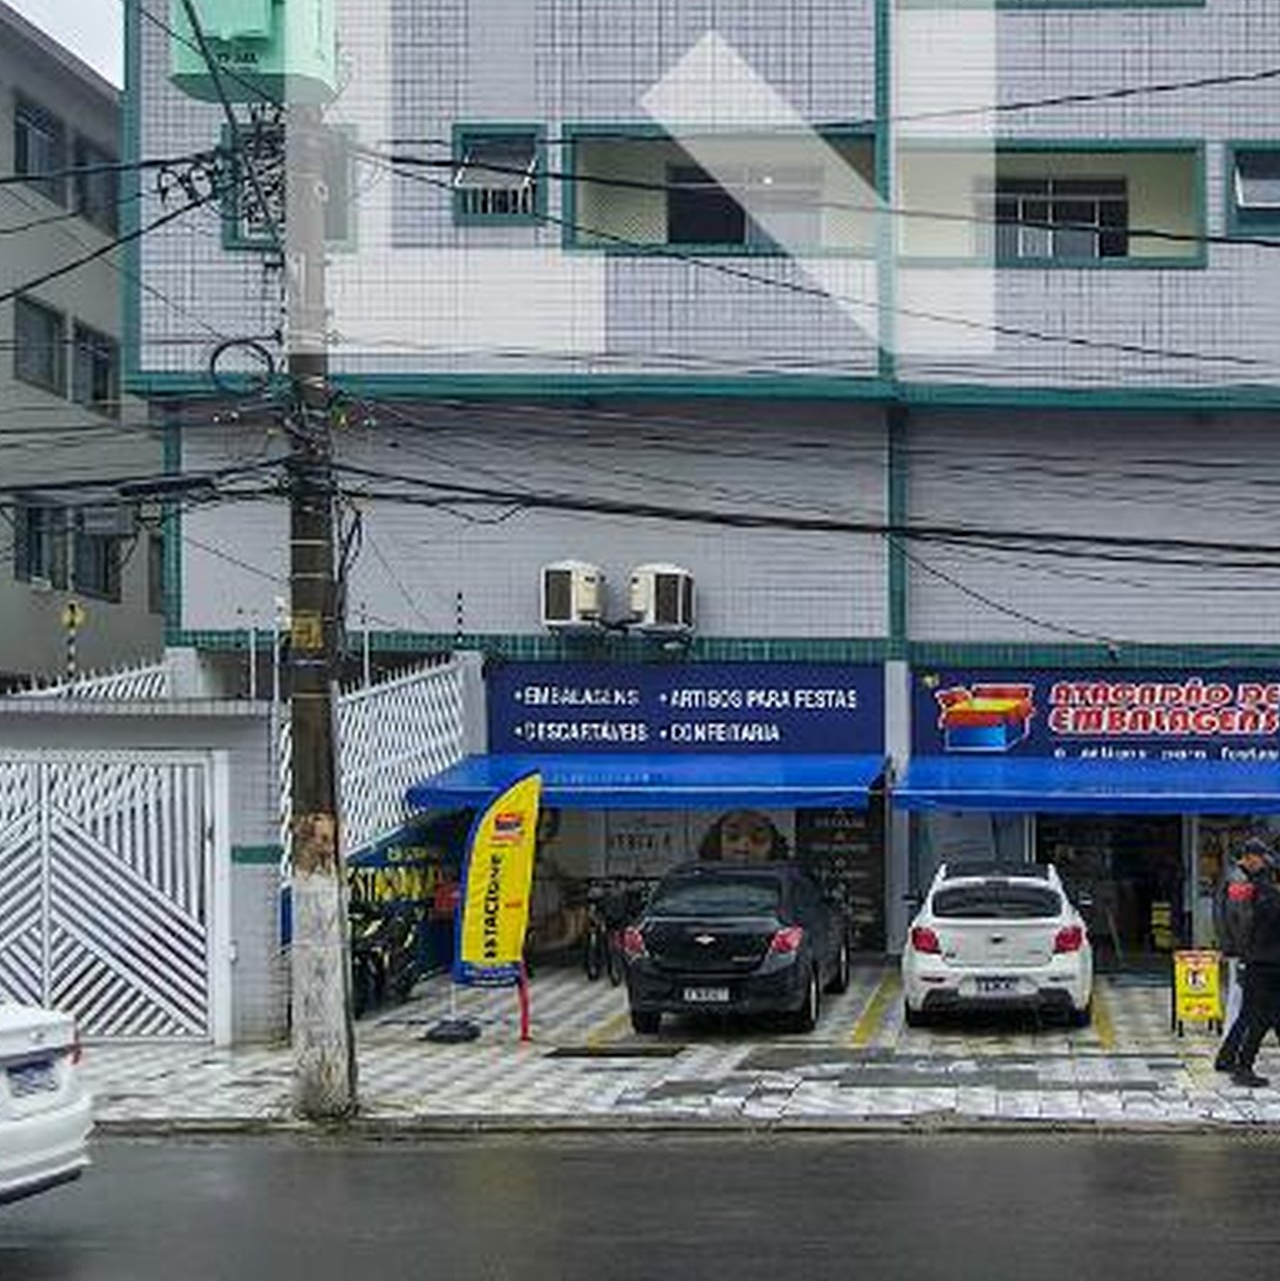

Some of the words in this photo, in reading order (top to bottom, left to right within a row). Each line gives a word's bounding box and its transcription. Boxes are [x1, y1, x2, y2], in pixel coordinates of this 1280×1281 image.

[670, 688, 742, 708] ARTIGOS
[746, 690, 791, 708] PARA
[794, 690, 857, 709] FESTAS
[670, 723, 780, 742] CONFEITARIA
